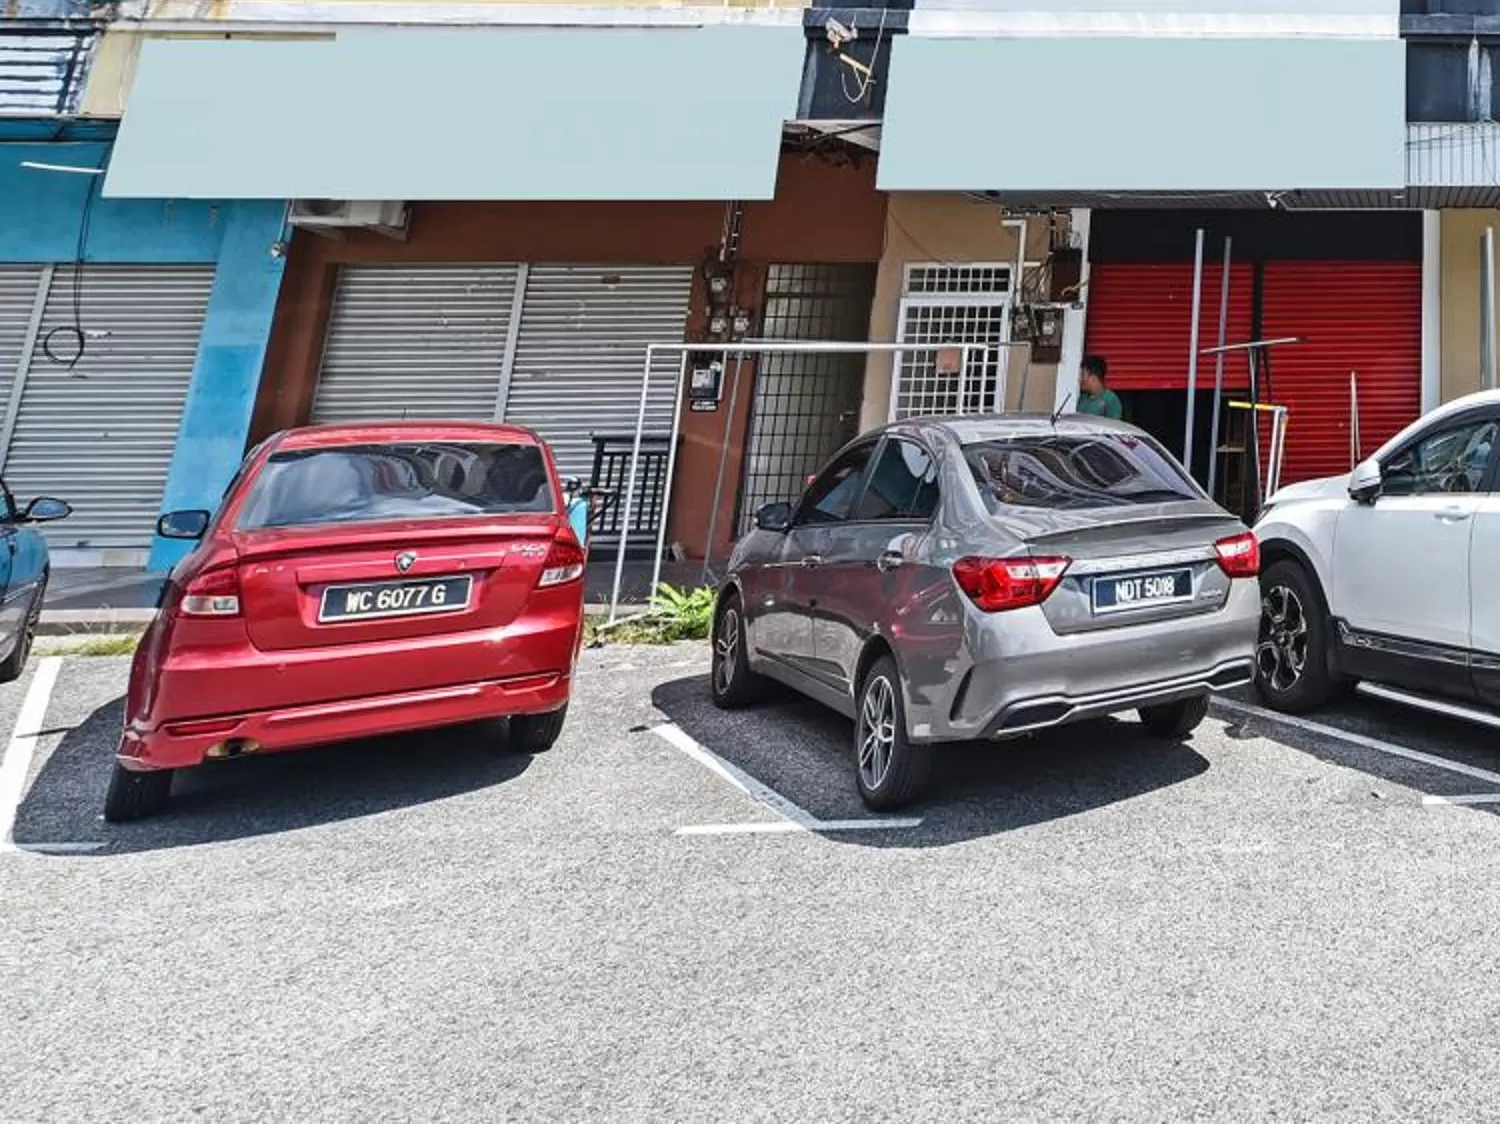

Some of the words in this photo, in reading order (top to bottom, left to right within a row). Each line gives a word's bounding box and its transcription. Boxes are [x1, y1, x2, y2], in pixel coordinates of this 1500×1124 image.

[345, 591, 372, 612] WC
[377, 585, 430, 609] 6077
[431, 584, 447, 604] G
[1115, 579, 1142, 602] NDT
